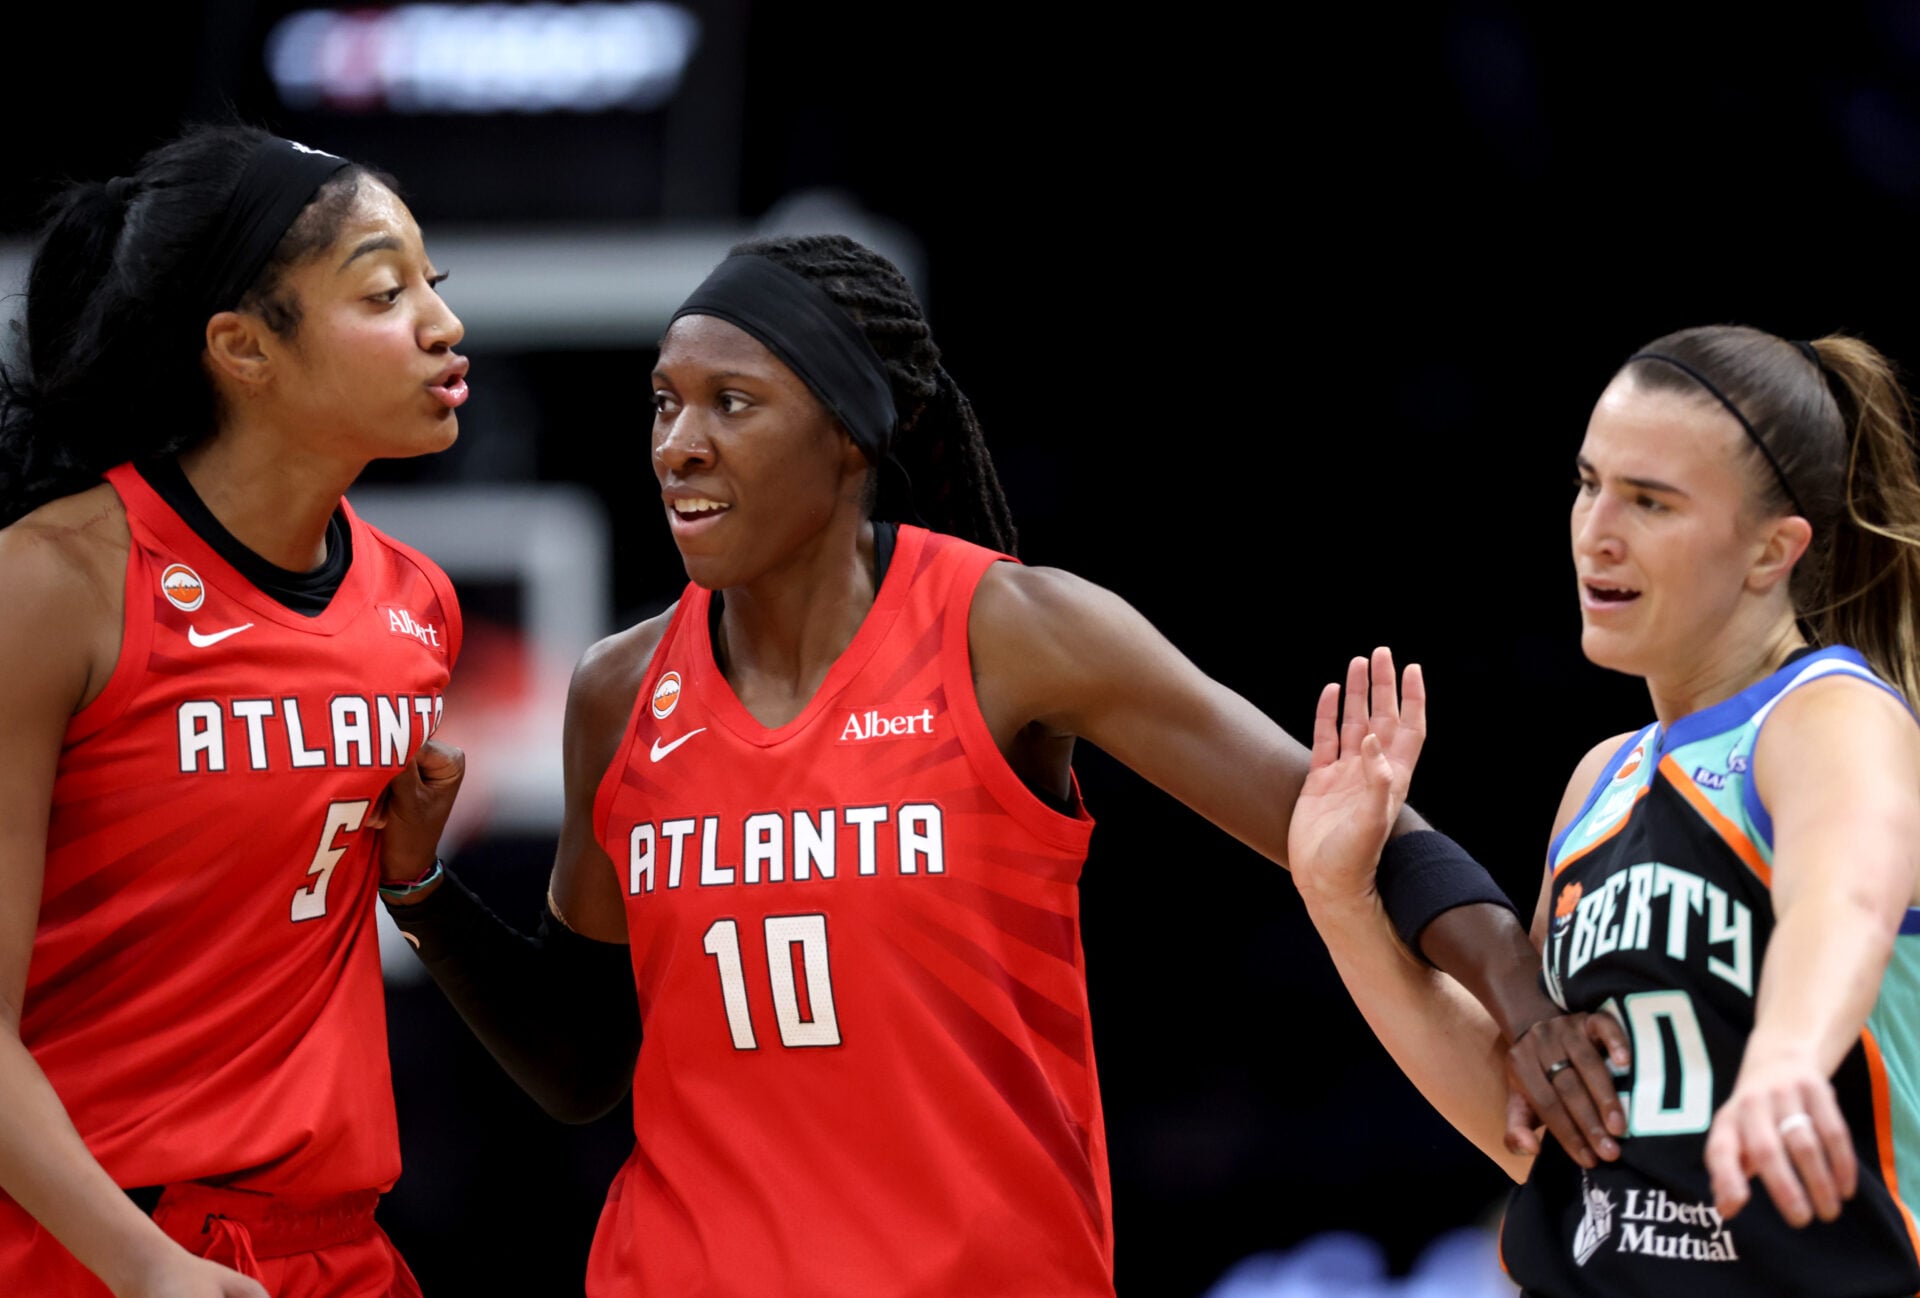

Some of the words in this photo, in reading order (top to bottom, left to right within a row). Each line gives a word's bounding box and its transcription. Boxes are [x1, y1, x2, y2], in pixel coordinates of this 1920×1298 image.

[840, 709, 934, 740] Albert
[290, 800, 370, 922] 5
[629, 803, 944, 895] ATLANTA
[703, 914, 841, 1050] 10
[1598, 990, 1713, 1137] 0
[1617, 1222, 1738, 1261] Mutual
[1621, 1189, 1724, 1239] Liberty
